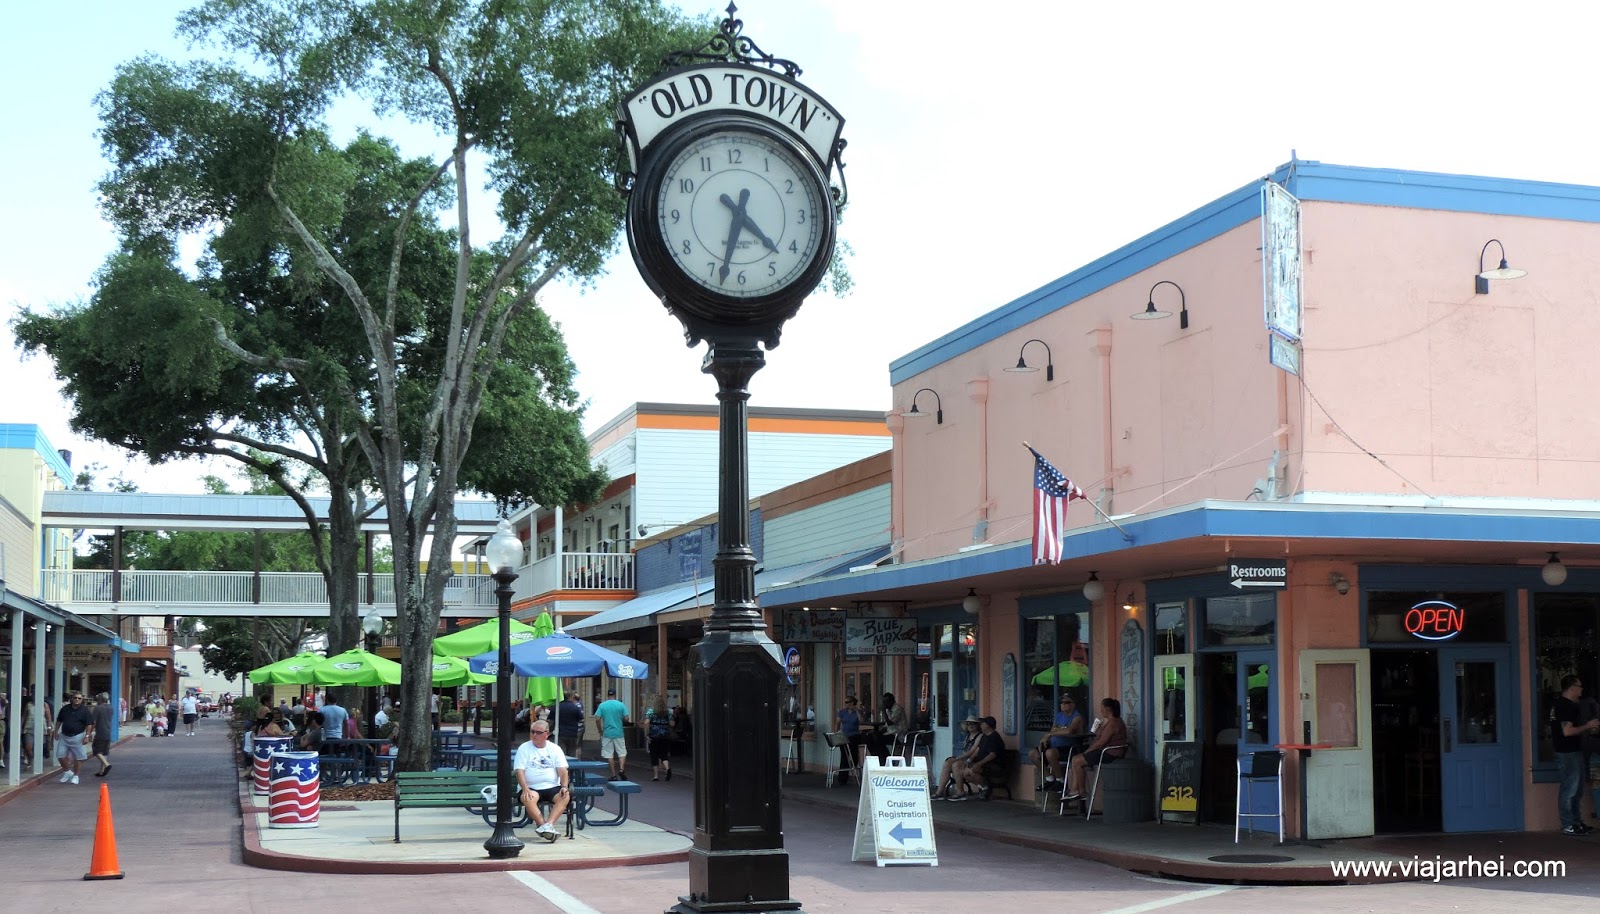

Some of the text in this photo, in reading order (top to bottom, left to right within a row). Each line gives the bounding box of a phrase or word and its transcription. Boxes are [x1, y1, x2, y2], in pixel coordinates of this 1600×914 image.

[700, 157, 712, 172] 11
[728, 149, 743, 165] 12
[764, 157, 770, 173] 1
[679, 178, 694, 194] 10
[785, 179, 794, 194] 2
[671, 209, 681, 225] 9
[797, 209, 806, 225] 3
[682, 239, 692, 255] 8
[788, 239, 798, 254] 4
[707, 262, 716, 277] 7
[768, 261, 776, 277] 5
[737, 270, 746, 285] 6
[1230, 564, 1286, 578] Restrooms
[1405, 608, 1464, 633] OPEN
[872, 625, 903, 646] MAX
[872, 776, 926, 787] Welcome
[1168, 786, 1193, 799] 312
[887, 800, 916, 808] Cruiser
[878, 810, 927, 819] Registration
